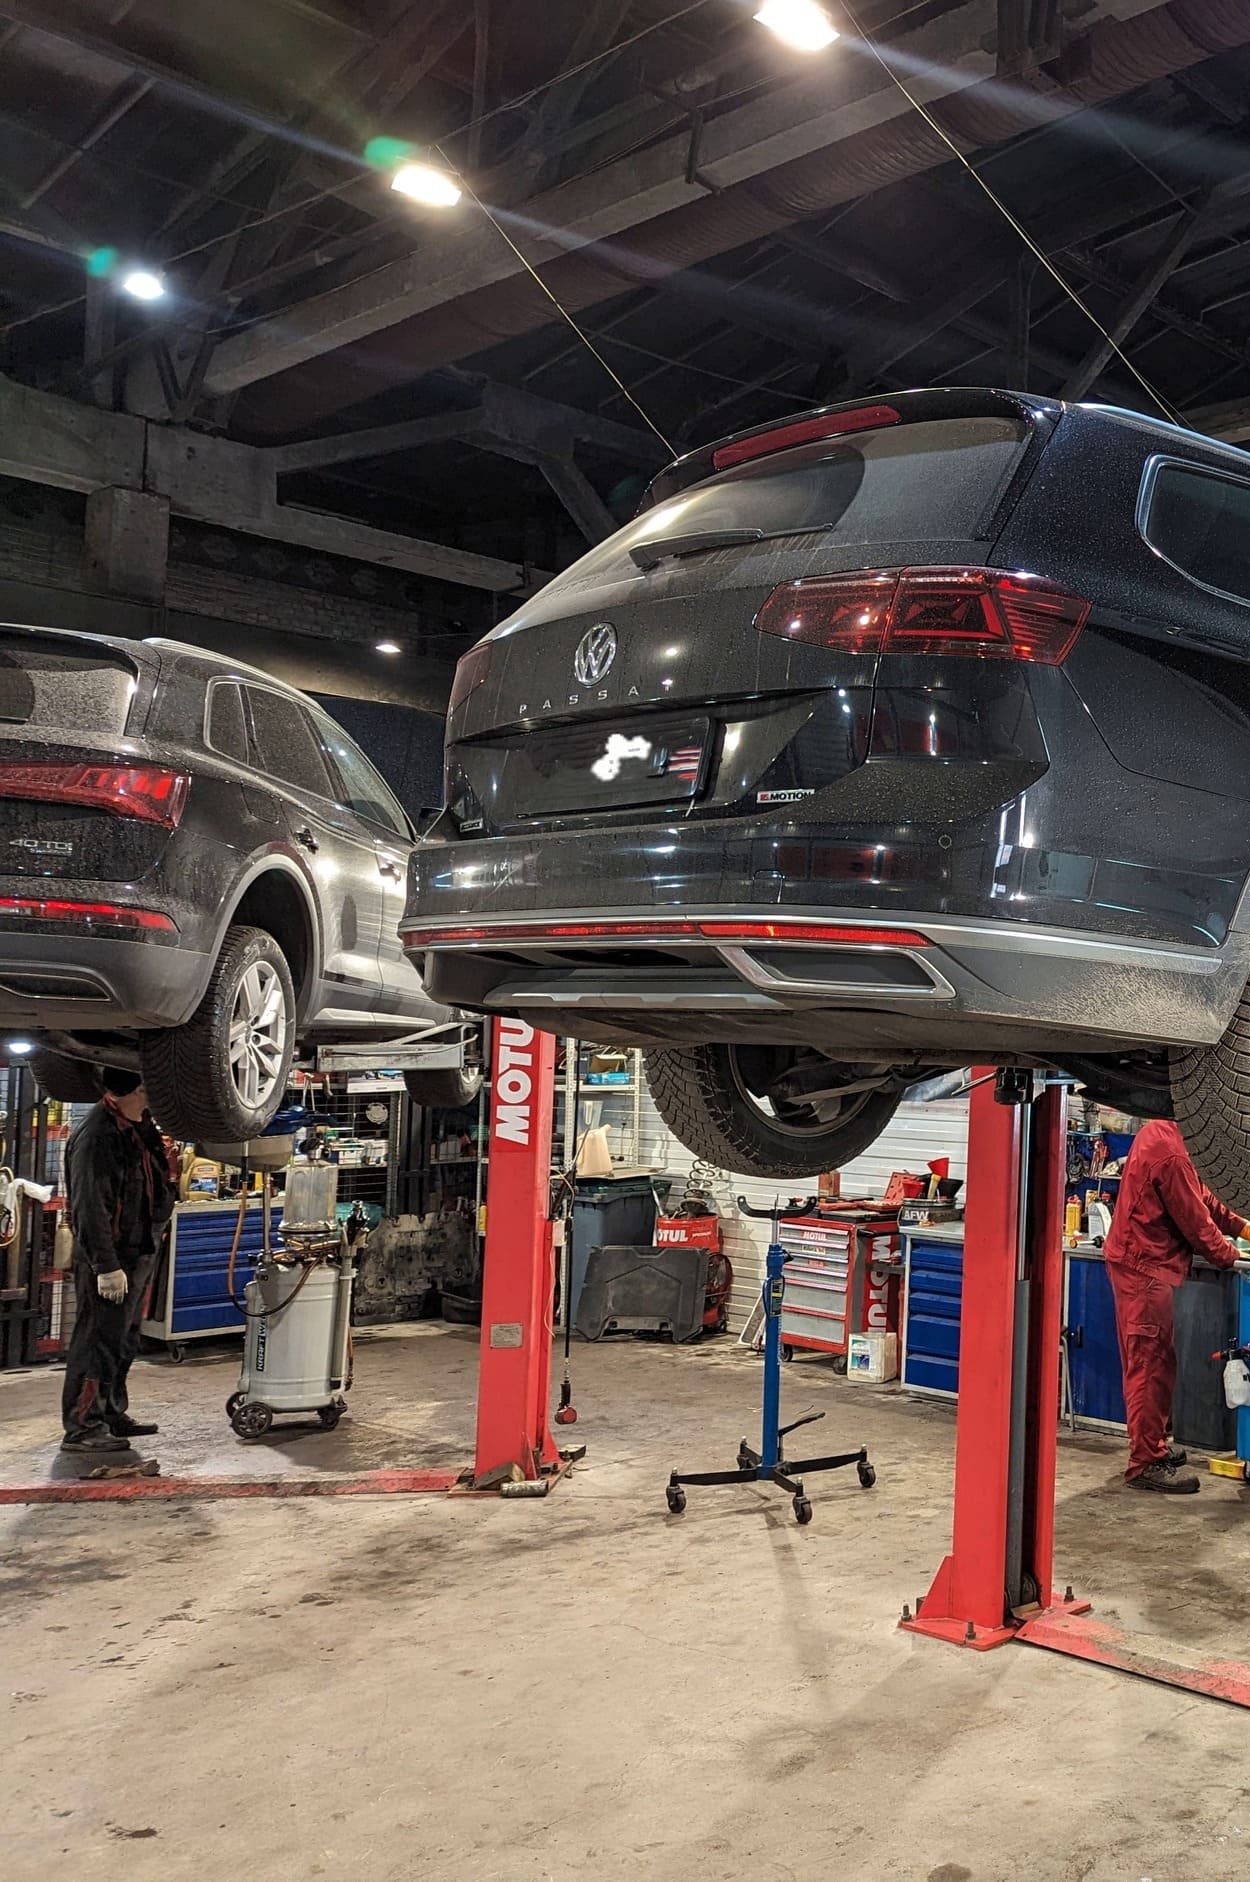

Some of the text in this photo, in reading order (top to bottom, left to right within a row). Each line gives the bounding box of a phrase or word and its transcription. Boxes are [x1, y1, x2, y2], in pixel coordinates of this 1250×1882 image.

[519, 679, 674, 715] PASSAT
[495, 1016, 534, 1145] MOTU
[657, 1229, 688, 1242] OTUL
